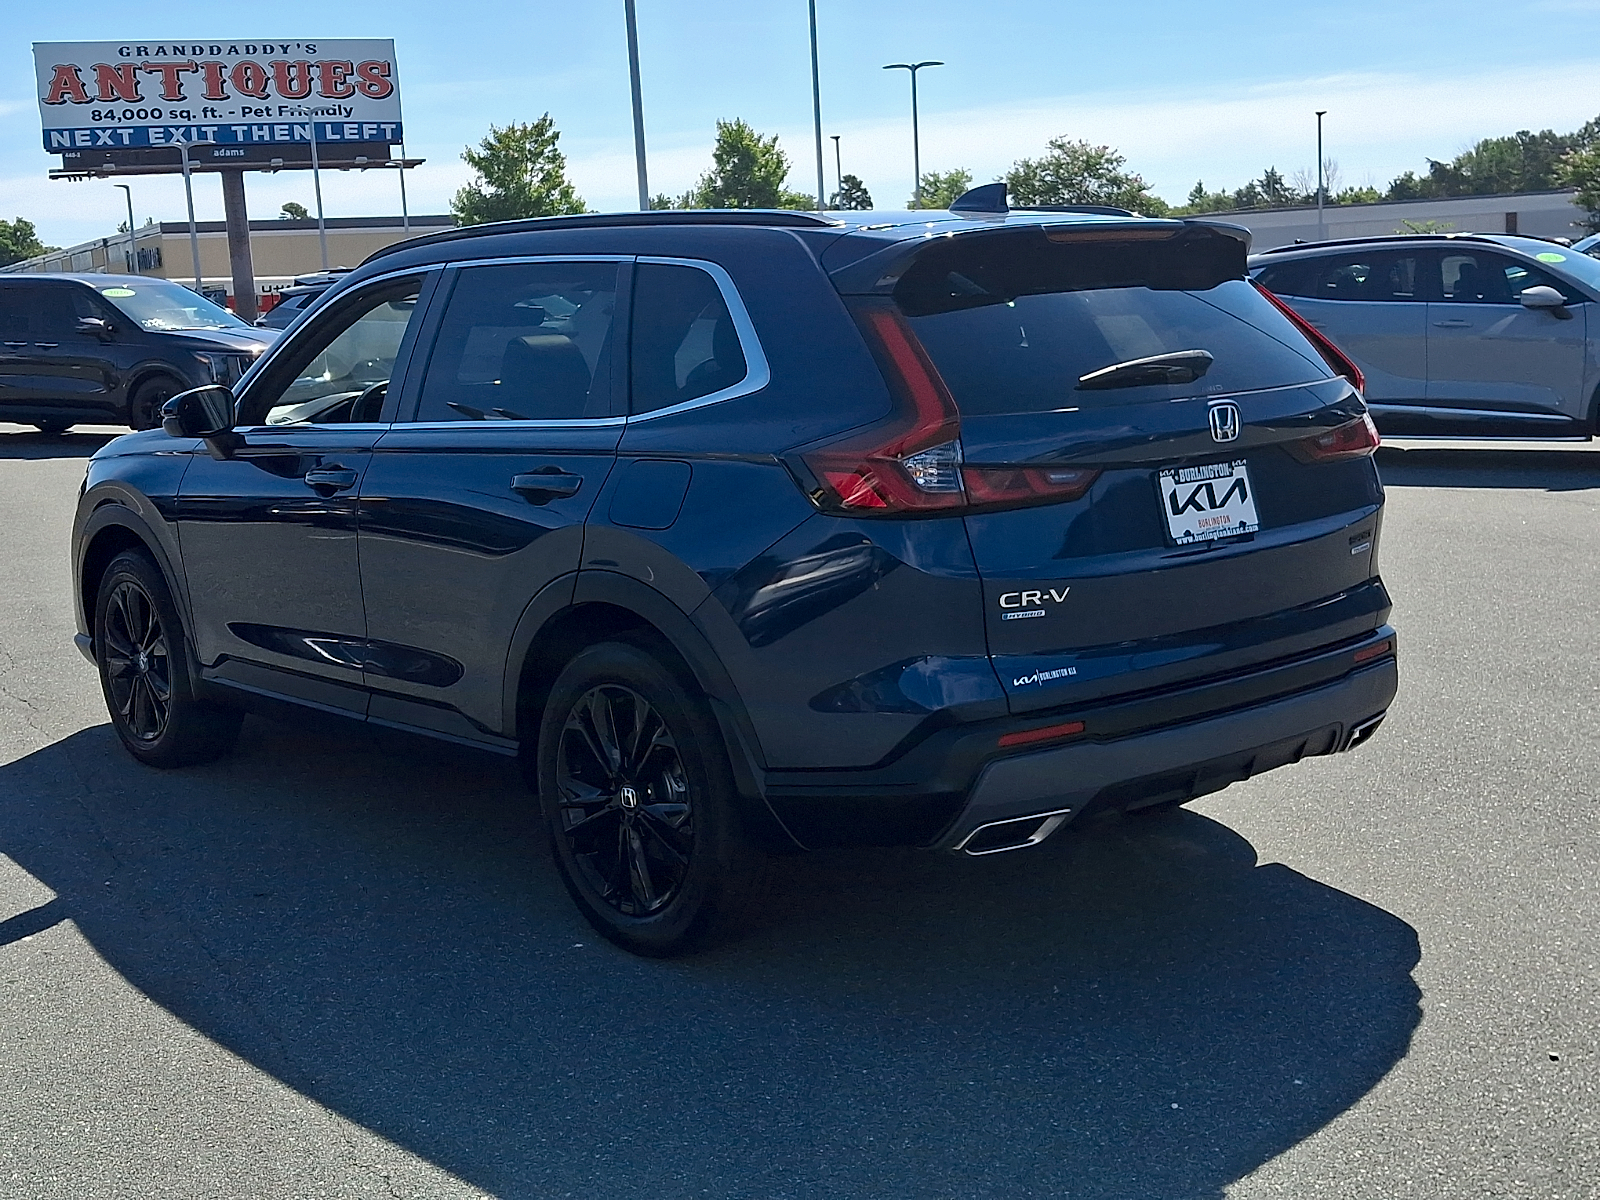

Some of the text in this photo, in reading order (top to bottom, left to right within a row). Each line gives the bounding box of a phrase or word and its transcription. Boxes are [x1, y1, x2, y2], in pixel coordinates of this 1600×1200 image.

[118, 43, 317, 57] GRANDDADDY'S
[41, 59, 394, 104] ANTIQUES
[91, 107, 163, 123] 84,000
[169, 108, 197, 121] sq.
[202, 106, 223, 119] ft.
[241, 104, 273, 118] Pet
[50, 123, 396, 148] NEXT EXIT THEN LEFT
[213, 149, 245, 157] adams
[1178, 462, 1230, 483] BURLINGTON
[1169, 477, 1248, 516] KIA
[1198, 515, 1231, 529] BURLINGTON
[999, 586, 1071, 608] CR-V
